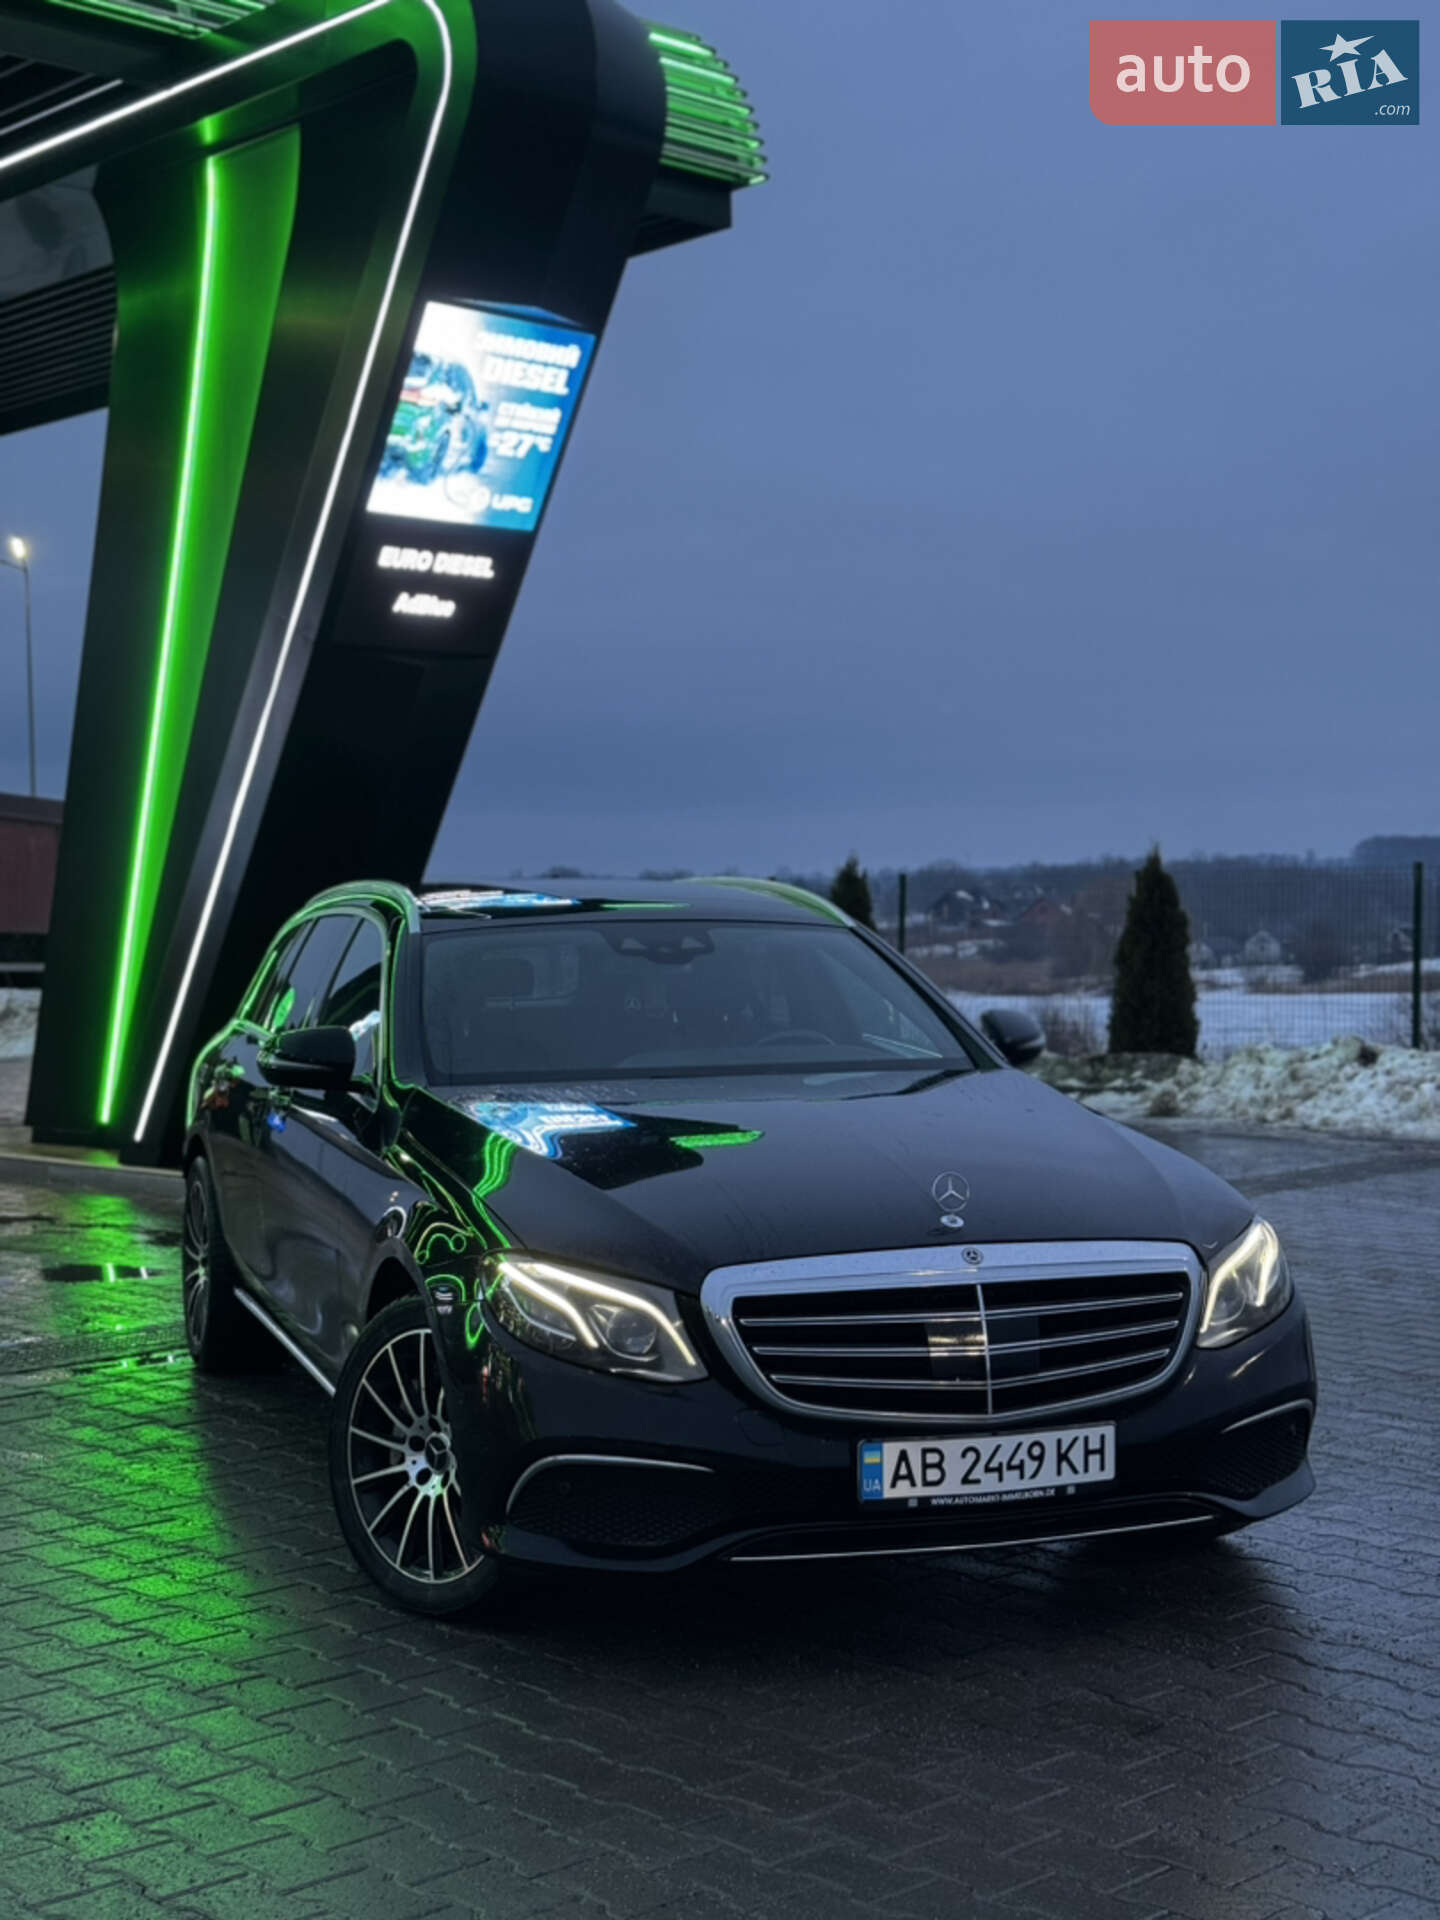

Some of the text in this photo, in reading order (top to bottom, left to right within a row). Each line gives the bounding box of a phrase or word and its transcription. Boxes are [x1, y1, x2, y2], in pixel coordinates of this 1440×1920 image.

[482, 355, 569, 395] DIESEL
[378, 545, 495, 578] EURO DIESEL
[890, 1433, 1107, 1489] AB 2449 KH
[863, 1478, 882, 1493] UA
